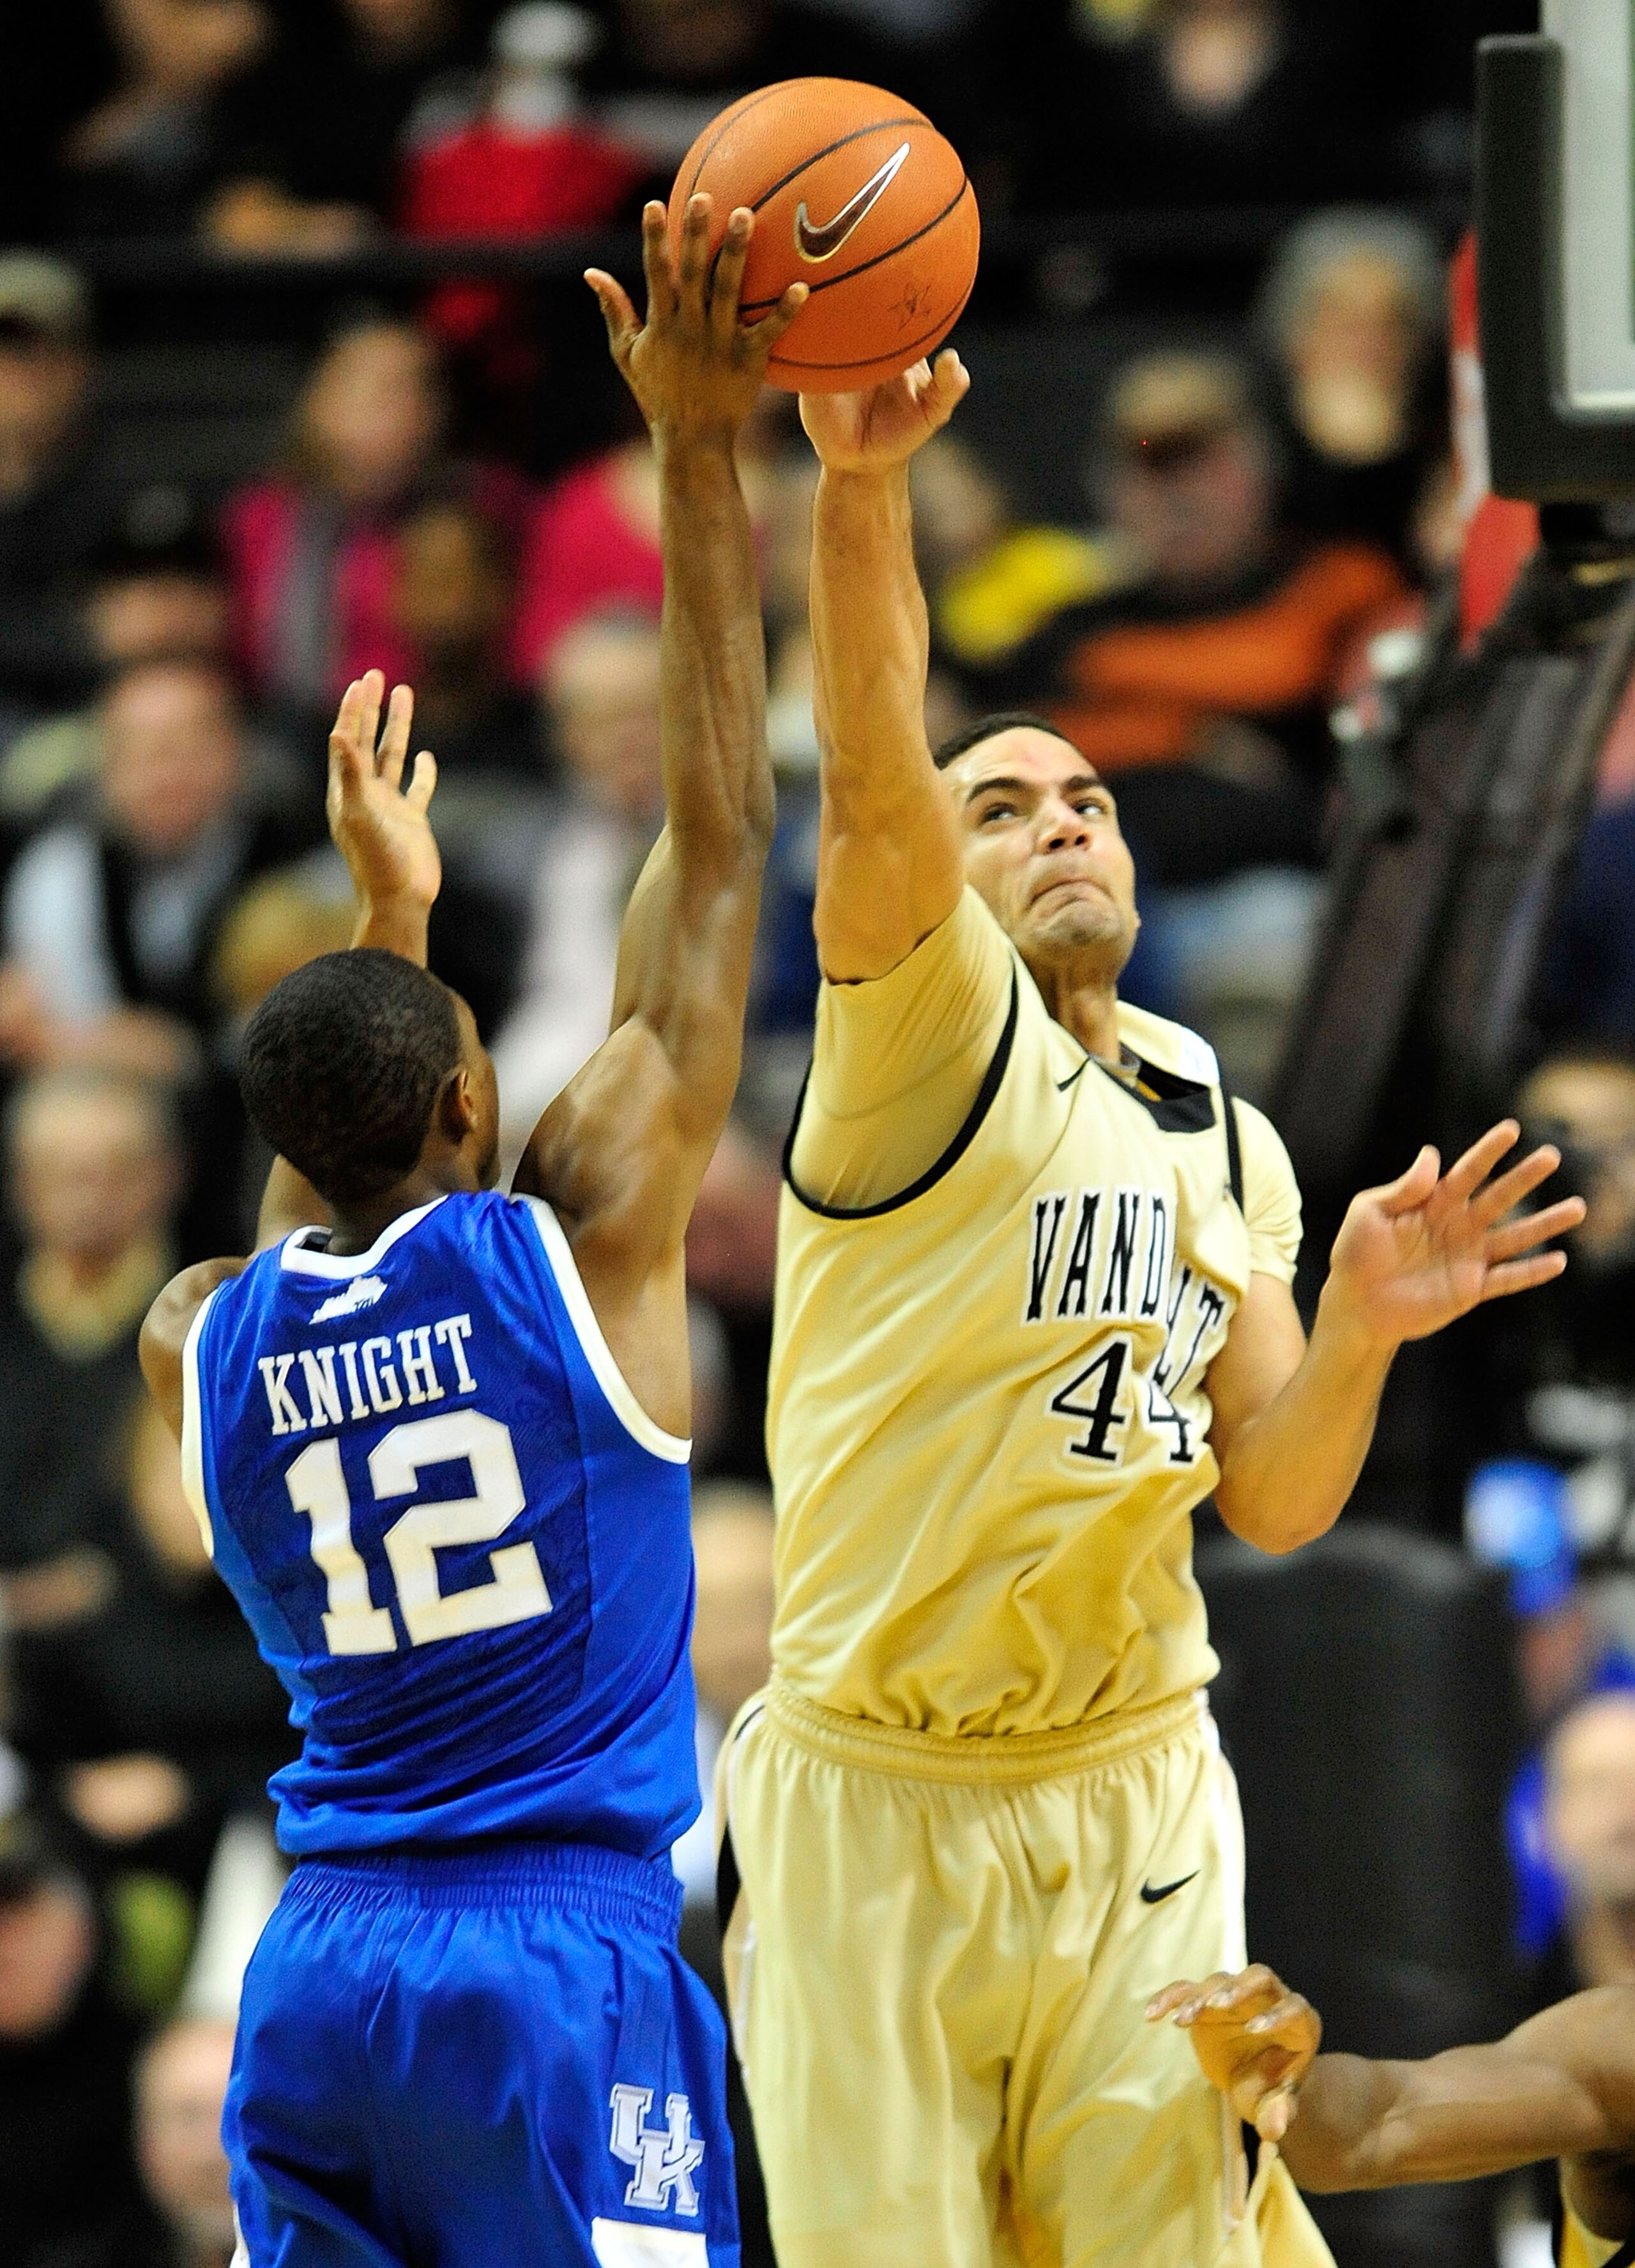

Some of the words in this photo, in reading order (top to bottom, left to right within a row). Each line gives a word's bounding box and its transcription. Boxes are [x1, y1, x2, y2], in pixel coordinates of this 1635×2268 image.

[258, 1313, 478, 1435] KNIGHT
[1051, 1340, 1193, 1462] 44
[284, 1408, 553, 1655] 12
[610, 2083, 706, 2217] UK
